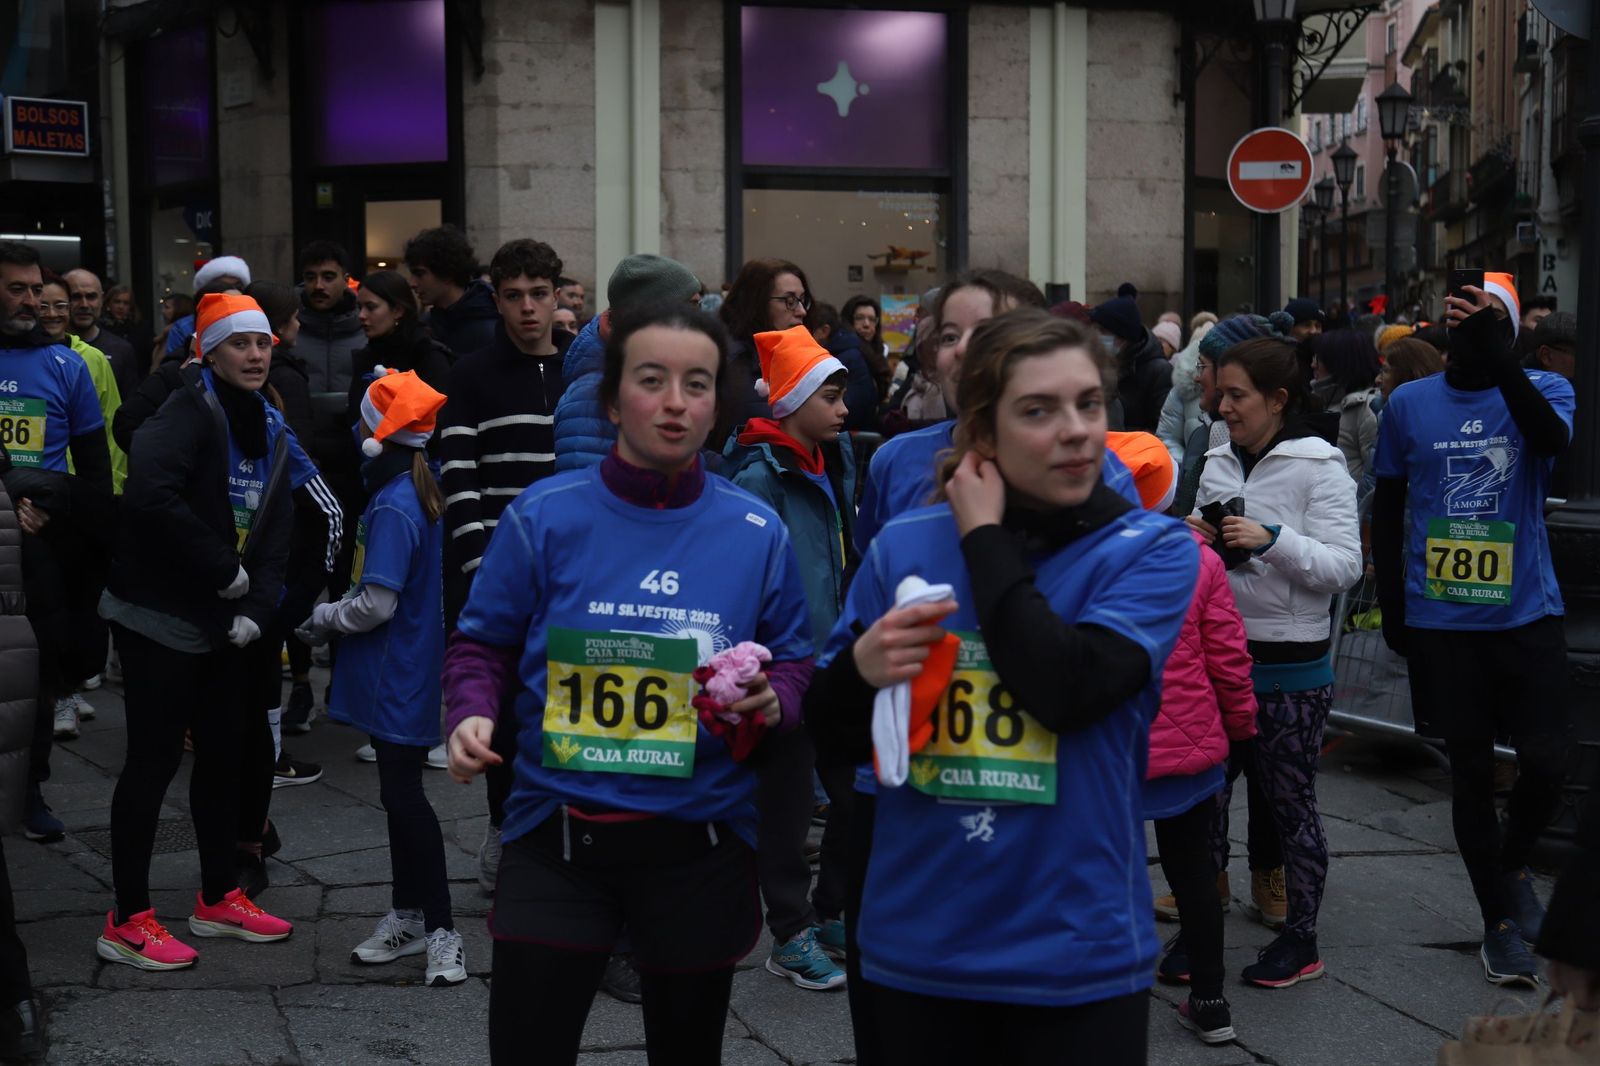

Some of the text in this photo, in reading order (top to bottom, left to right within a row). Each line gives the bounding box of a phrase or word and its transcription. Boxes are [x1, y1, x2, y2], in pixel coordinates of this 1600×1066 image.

[16, 105, 80, 127] BOLSOS
[14, 128, 86, 150] MALETAS
[1460, 420, 1483, 434] 46
[1449, 439, 1488, 448] SILVESTRE
[11, 454, 39, 463] RURAL
[238, 459, 254, 474] 46
[1431, 547, 1499, 582] 780
[639, 569, 680, 596] 46
[1447, 587, 1506, 600] CAJA RURAL
[588, 601, 721, 625] SAN SILVESTRE 2025
[585, 648, 655, 661] CAJA RURAL
[559, 672, 668, 730] 166
[583, 747, 685, 767] CAJA RURAL
[978, 770, 1045, 792] RURAL
